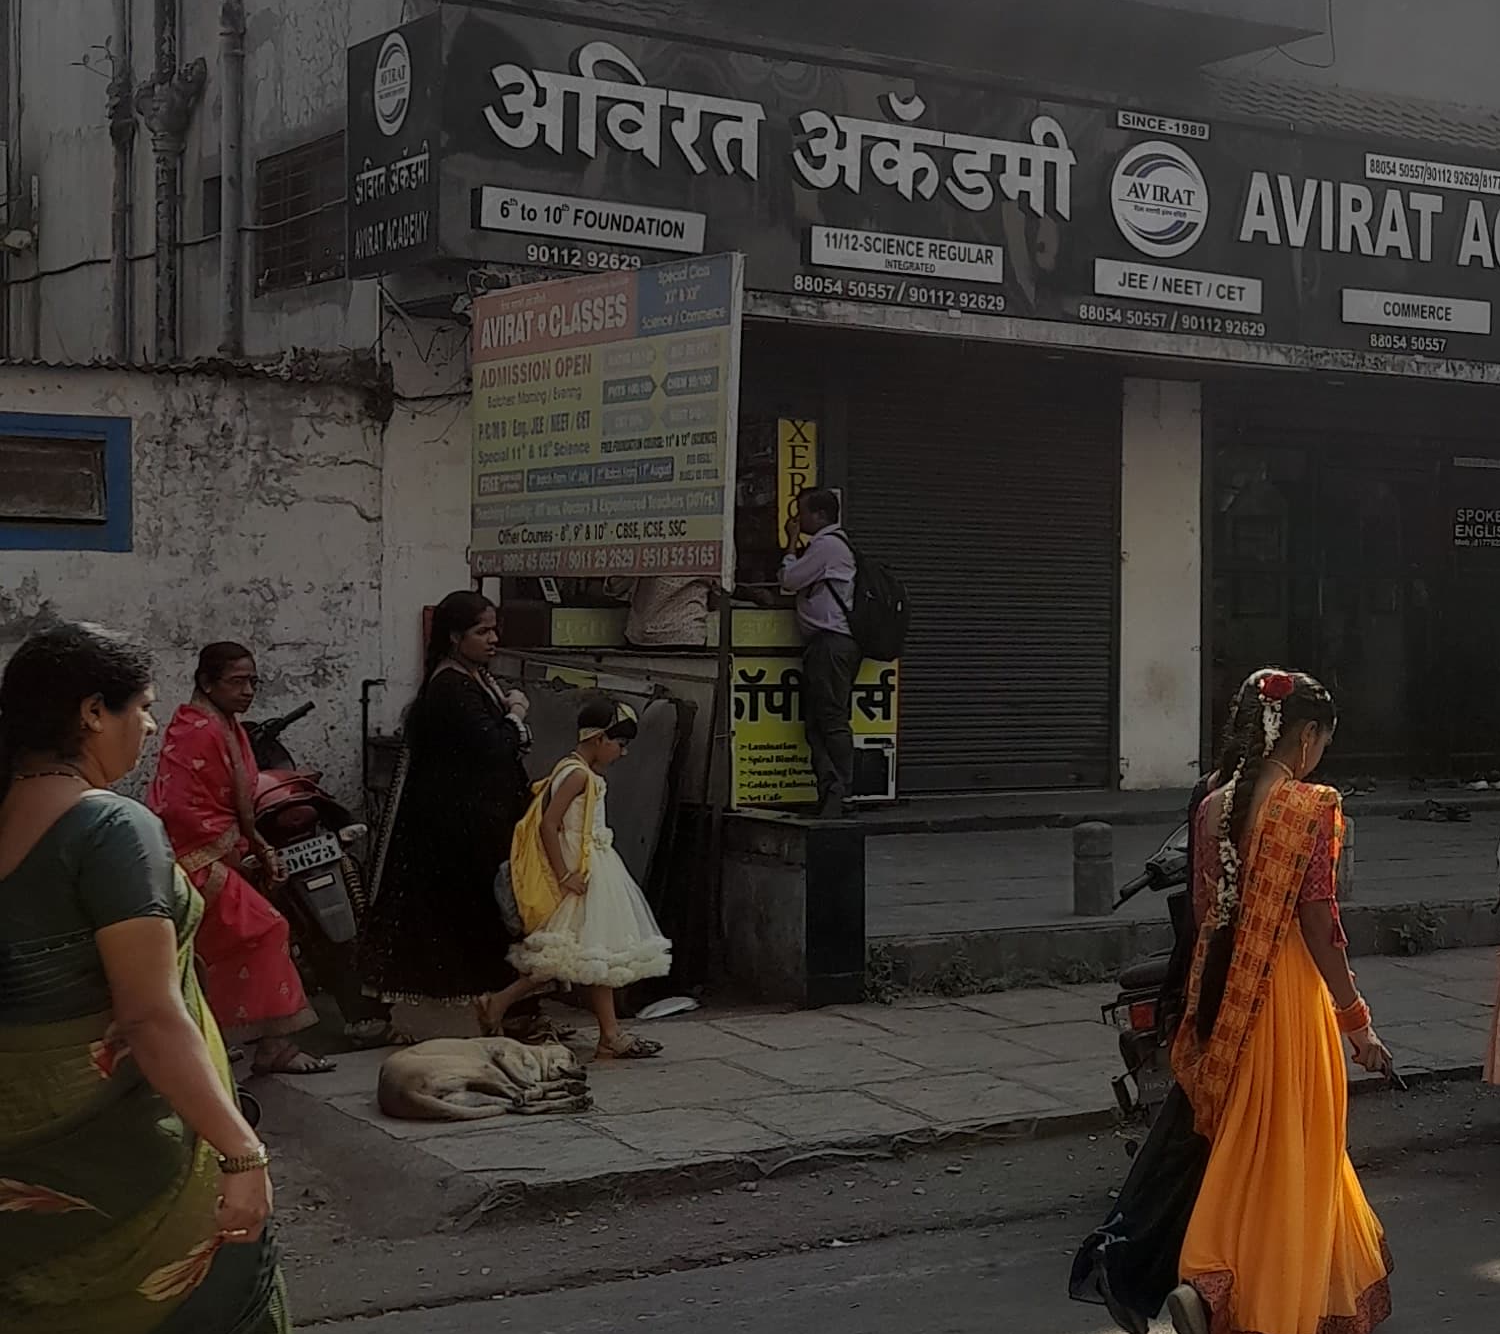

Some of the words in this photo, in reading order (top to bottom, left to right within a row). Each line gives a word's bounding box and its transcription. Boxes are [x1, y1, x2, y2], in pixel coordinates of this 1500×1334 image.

[484, 41, 766, 179] अविरत
[1126, 181, 1196, 207] AVIRAT
[521, 203, 538, 222] to
[573, 208, 686, 239] FOUNDATION
[1239, 170, 1443, 262] AVIRAT
[526, 243, 582, 267] 90112
[586, 246, 642, 271] 92629
[824, 232, 924, 259] 11/12-SCIENCE
[929, 242, 995, 266] REGULAR
[884, 258, 936, 274] INTEGRATED
[794, 274, 843, 296] 88054
[848, 280, 896, 300] 50557
[909, 287, 955, 307] 90112
[959, 291, 1005, 311] 92629
[1118, 271, 1149, 291] JEE
[1162, 276, 1203, 297] NEET
[1215, 283, 1246, 302] CET
[480, 310, 535, 350] AVIRAT
[549, 293, 629, 338] CLASSES
[1079, 304, 1123, 324] 88054
[1126, 309, 1168, 328] 50557
[1181, 314, 1222, 334] 90112
[1225, 318, 1266, 337] 92629
[1383, 300, 1453, 323] COMMERCE
[1369, 332, 1407, 350] 88054
[1409, 335, 1448, 353] 50557
[480, 357, 551, 390] ADMISSION
[555, 352, 592, 379] OPEN
[668, 519, 687, 537] SSC
